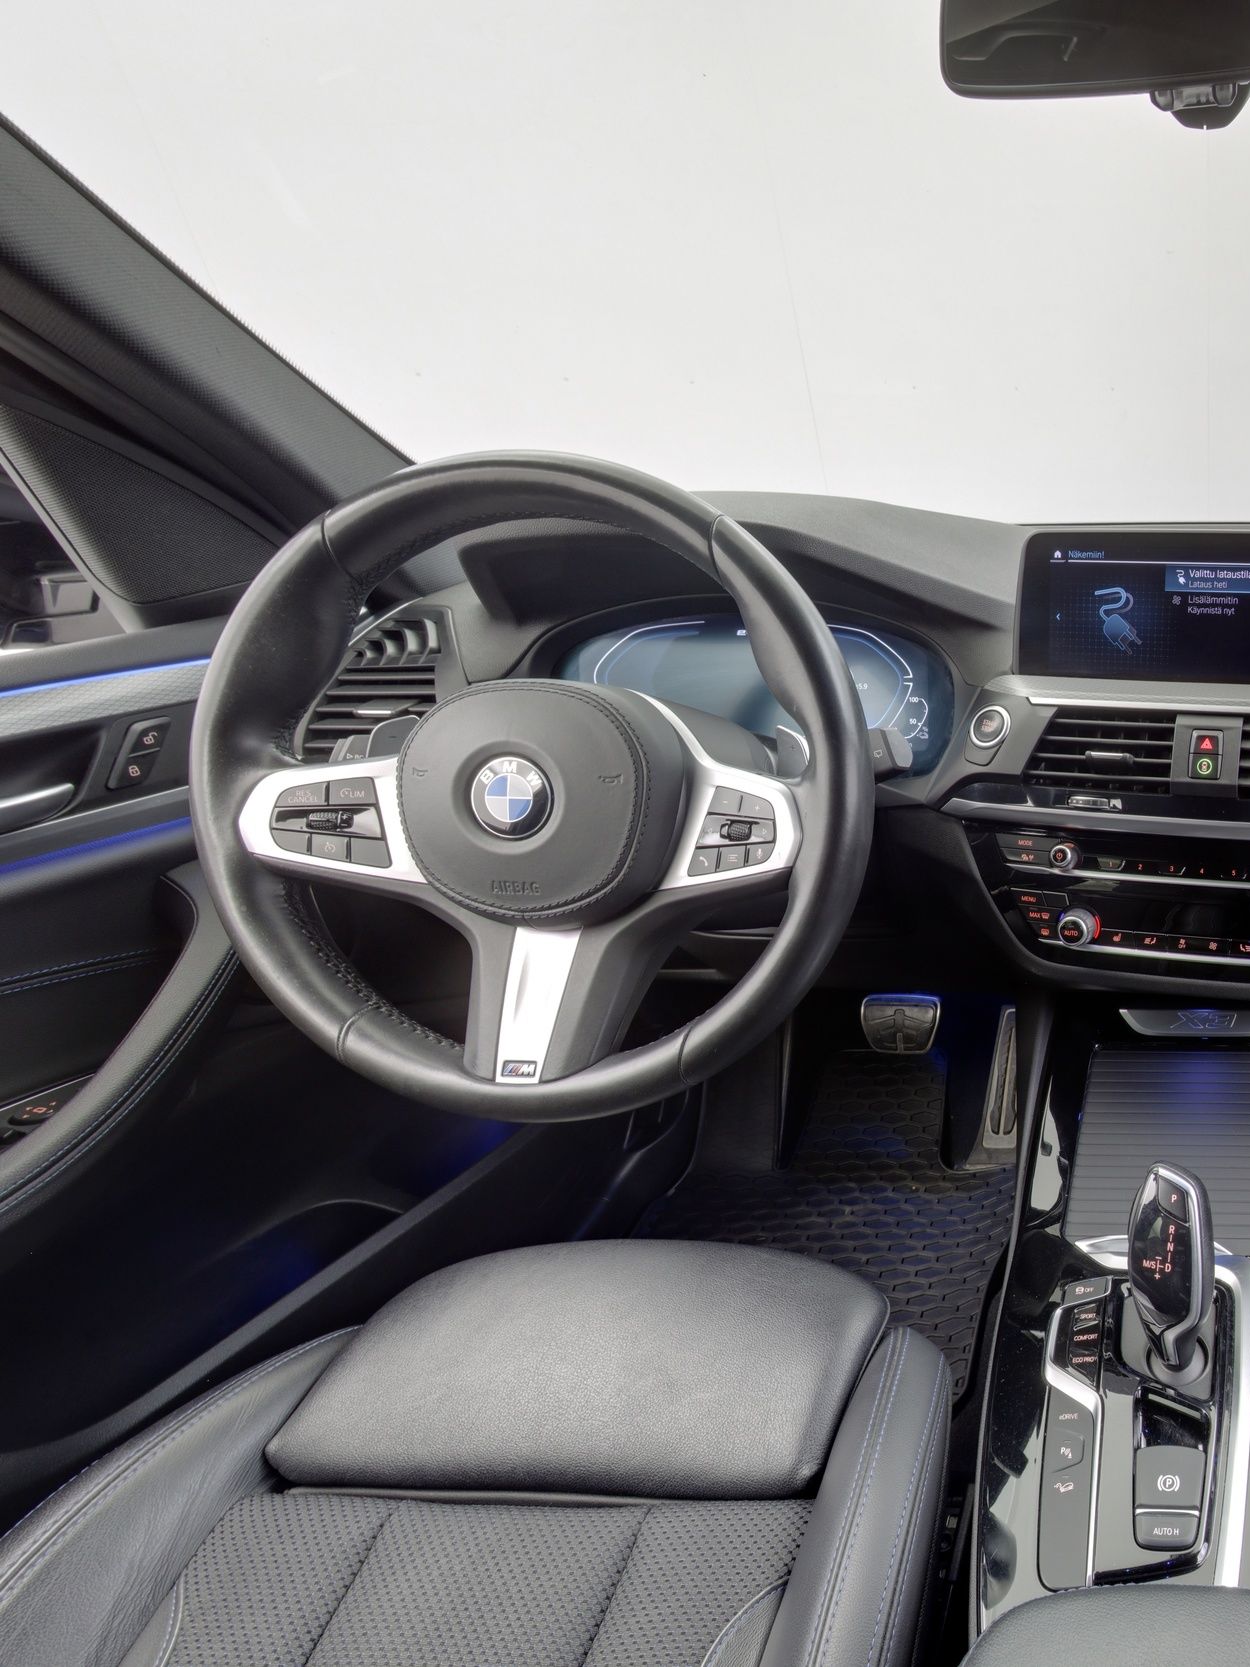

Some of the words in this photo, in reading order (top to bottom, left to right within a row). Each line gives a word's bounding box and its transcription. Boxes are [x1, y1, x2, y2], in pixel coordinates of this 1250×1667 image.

[1068, 550, 1105, 559] Näkemiin!
[1189, 569, 1215, 579] Valittu
[1188, 580, 1212, 589] Lataus
[1213, 581, 1228, 589] heti
[1187, 595, 1239, 605] Lisälämmitin
[1187, 606, 1222, 615] Käynnistä
[1223, 607, 1235, 616] nyt
[480, 761, 543, 788] BMW
[349, 790, 365, 799] LIM
[1017, 839, 1033, 847] MODE
[491, 879, 541, 896] AIRBAG
[1021, 895, 1037, 903] MENU
[1029, 911, 1041, 919] MAX
[1063, 929, 1079, 937] AUTO
[1171, 1194, 1177, 1203] P
[1168, 1225, 1175, 1234] R
[1167, 1242, 1174, 1252] N
[1142, 1259, 1156, 1269] M/S
[1164, 1263, 1172, 1272] D
[1073, 1333, 1099, 1341] COMFORT
[1152, 1527, 1173, 1536] AUTO
[1173, 1528, 1180, 1536] H
